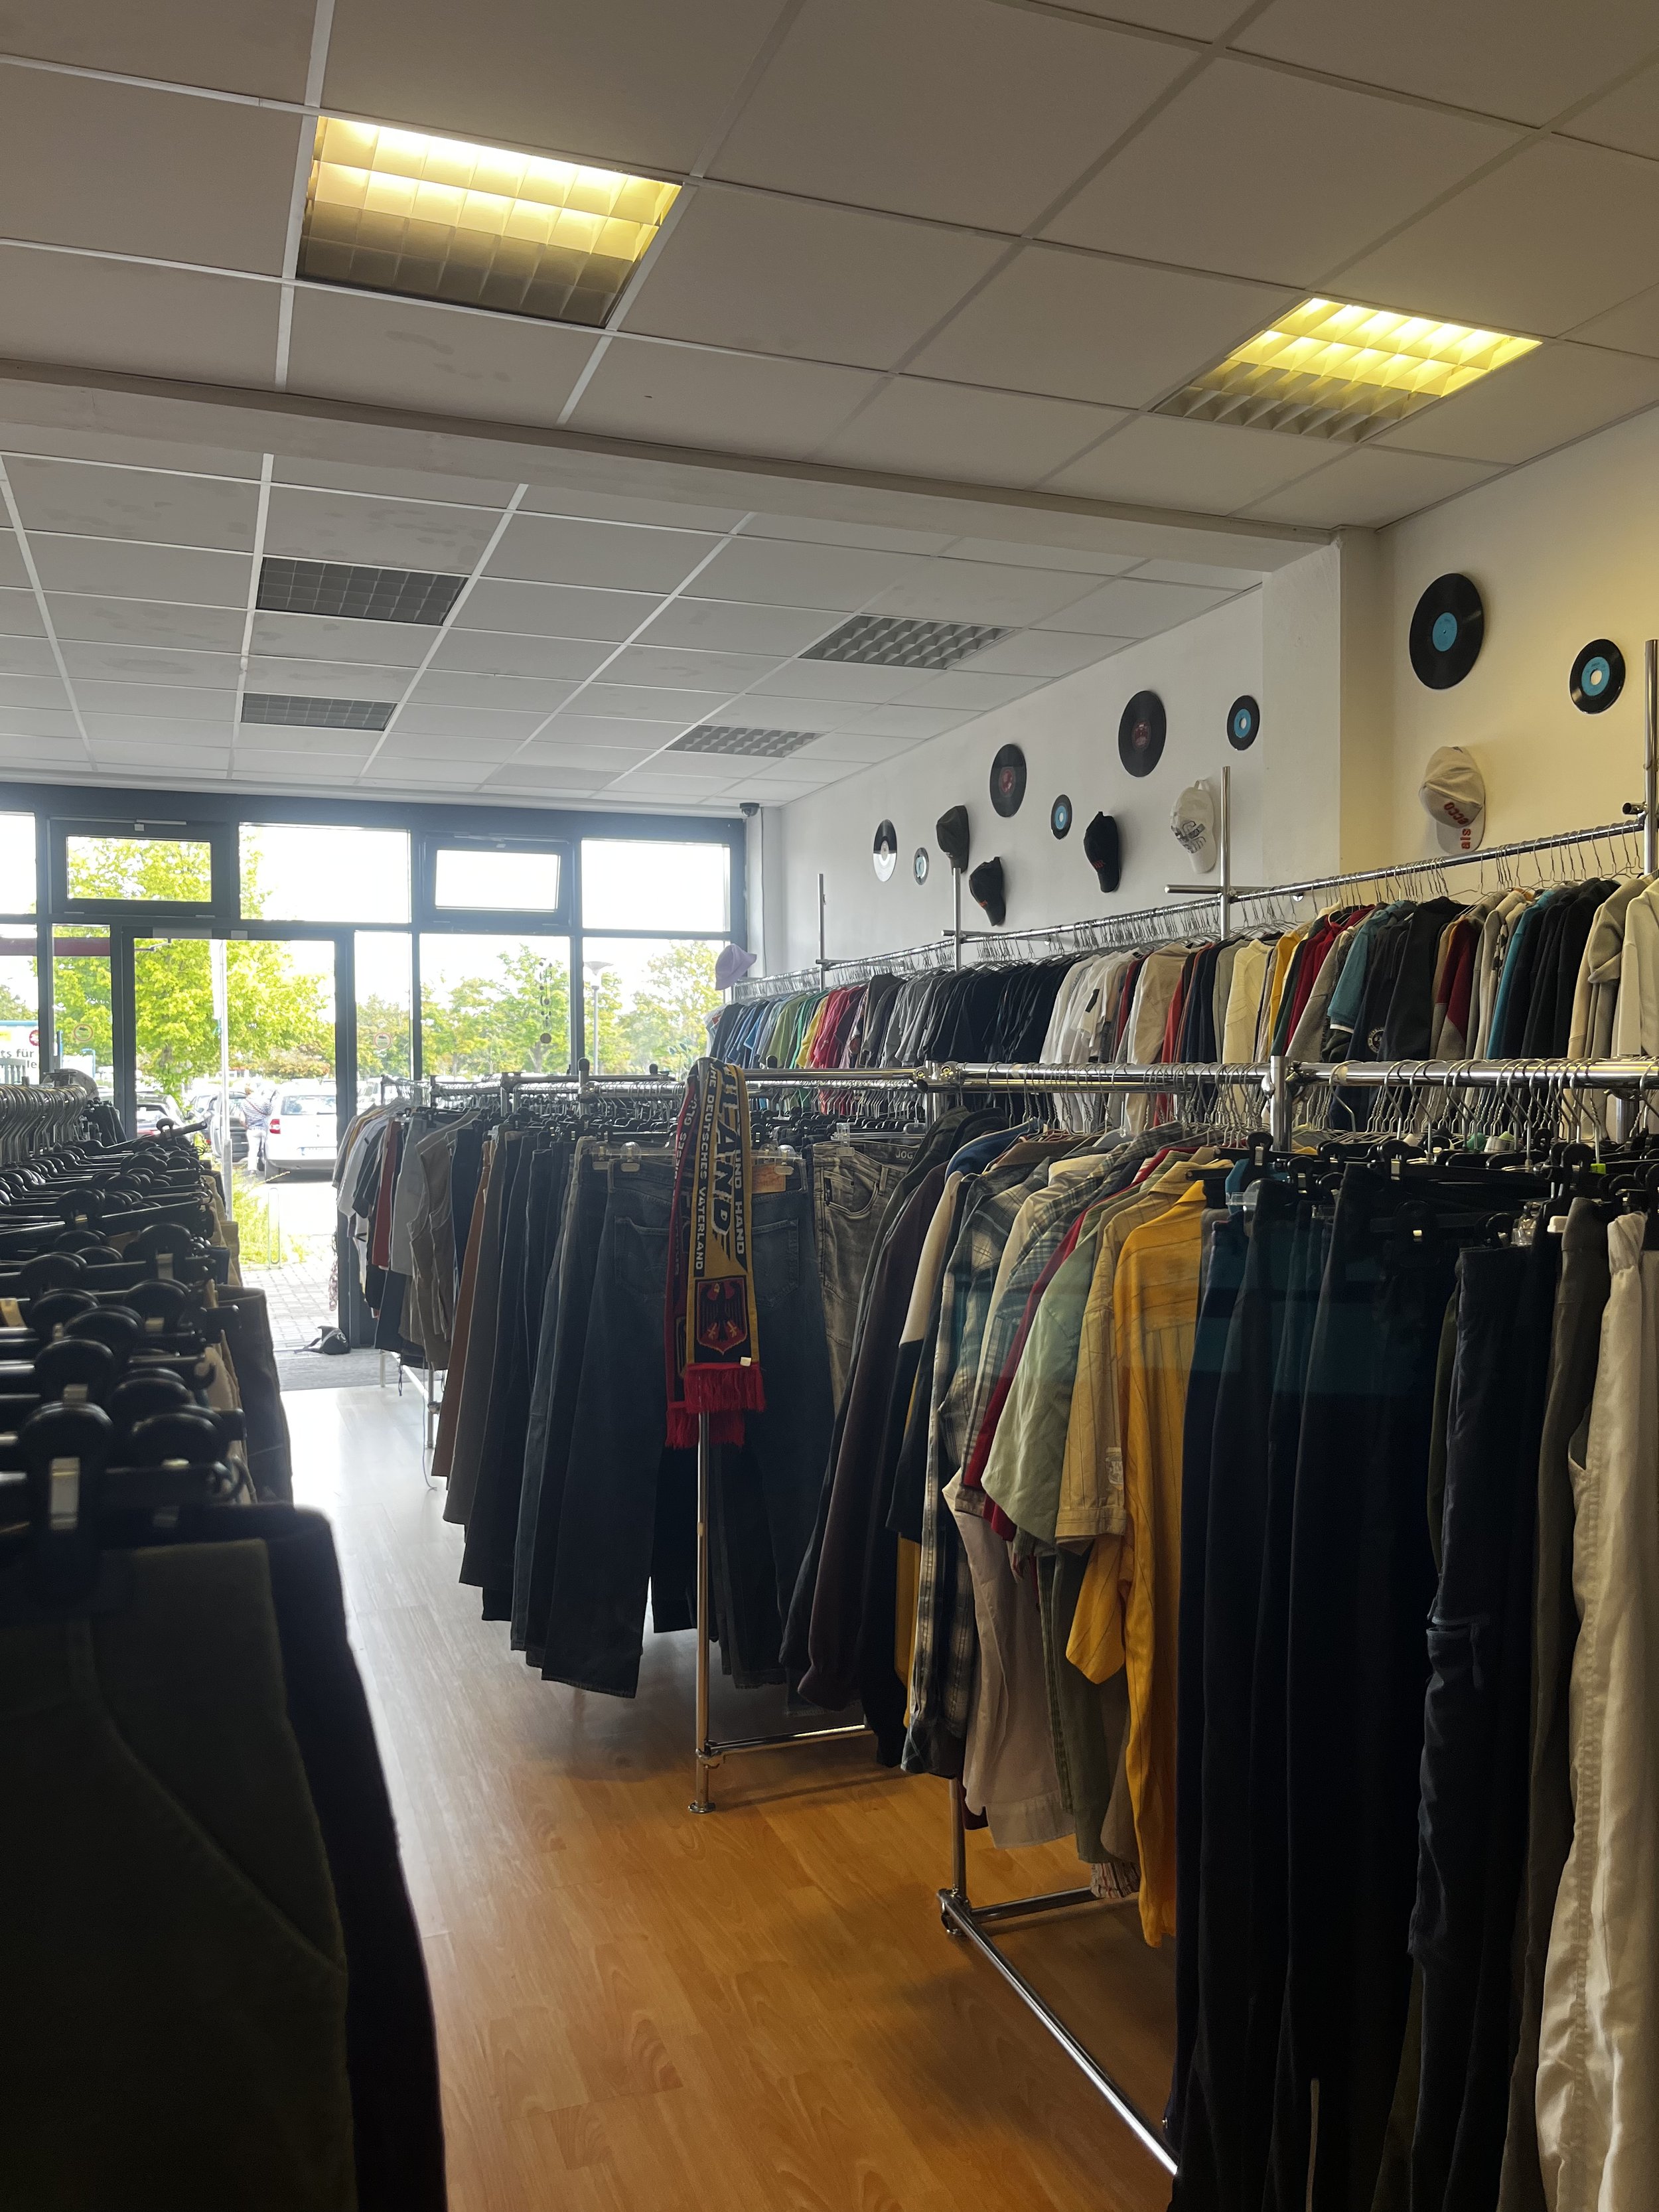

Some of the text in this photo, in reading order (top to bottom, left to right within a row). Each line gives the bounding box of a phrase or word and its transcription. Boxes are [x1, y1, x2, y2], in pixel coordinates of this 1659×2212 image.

[1444, 802, 1469, 824] ecco
[16, 1049, 35, 1058] für
[27, 1060, 38, 1069] le
[699, 1094, 715, 1179] DEUTSCHES
[896, 1150, 913, 1159] JOG
[695, 1187, 707, 1270] VATERLAND
[735, 1201, 745, 1255] HAND
